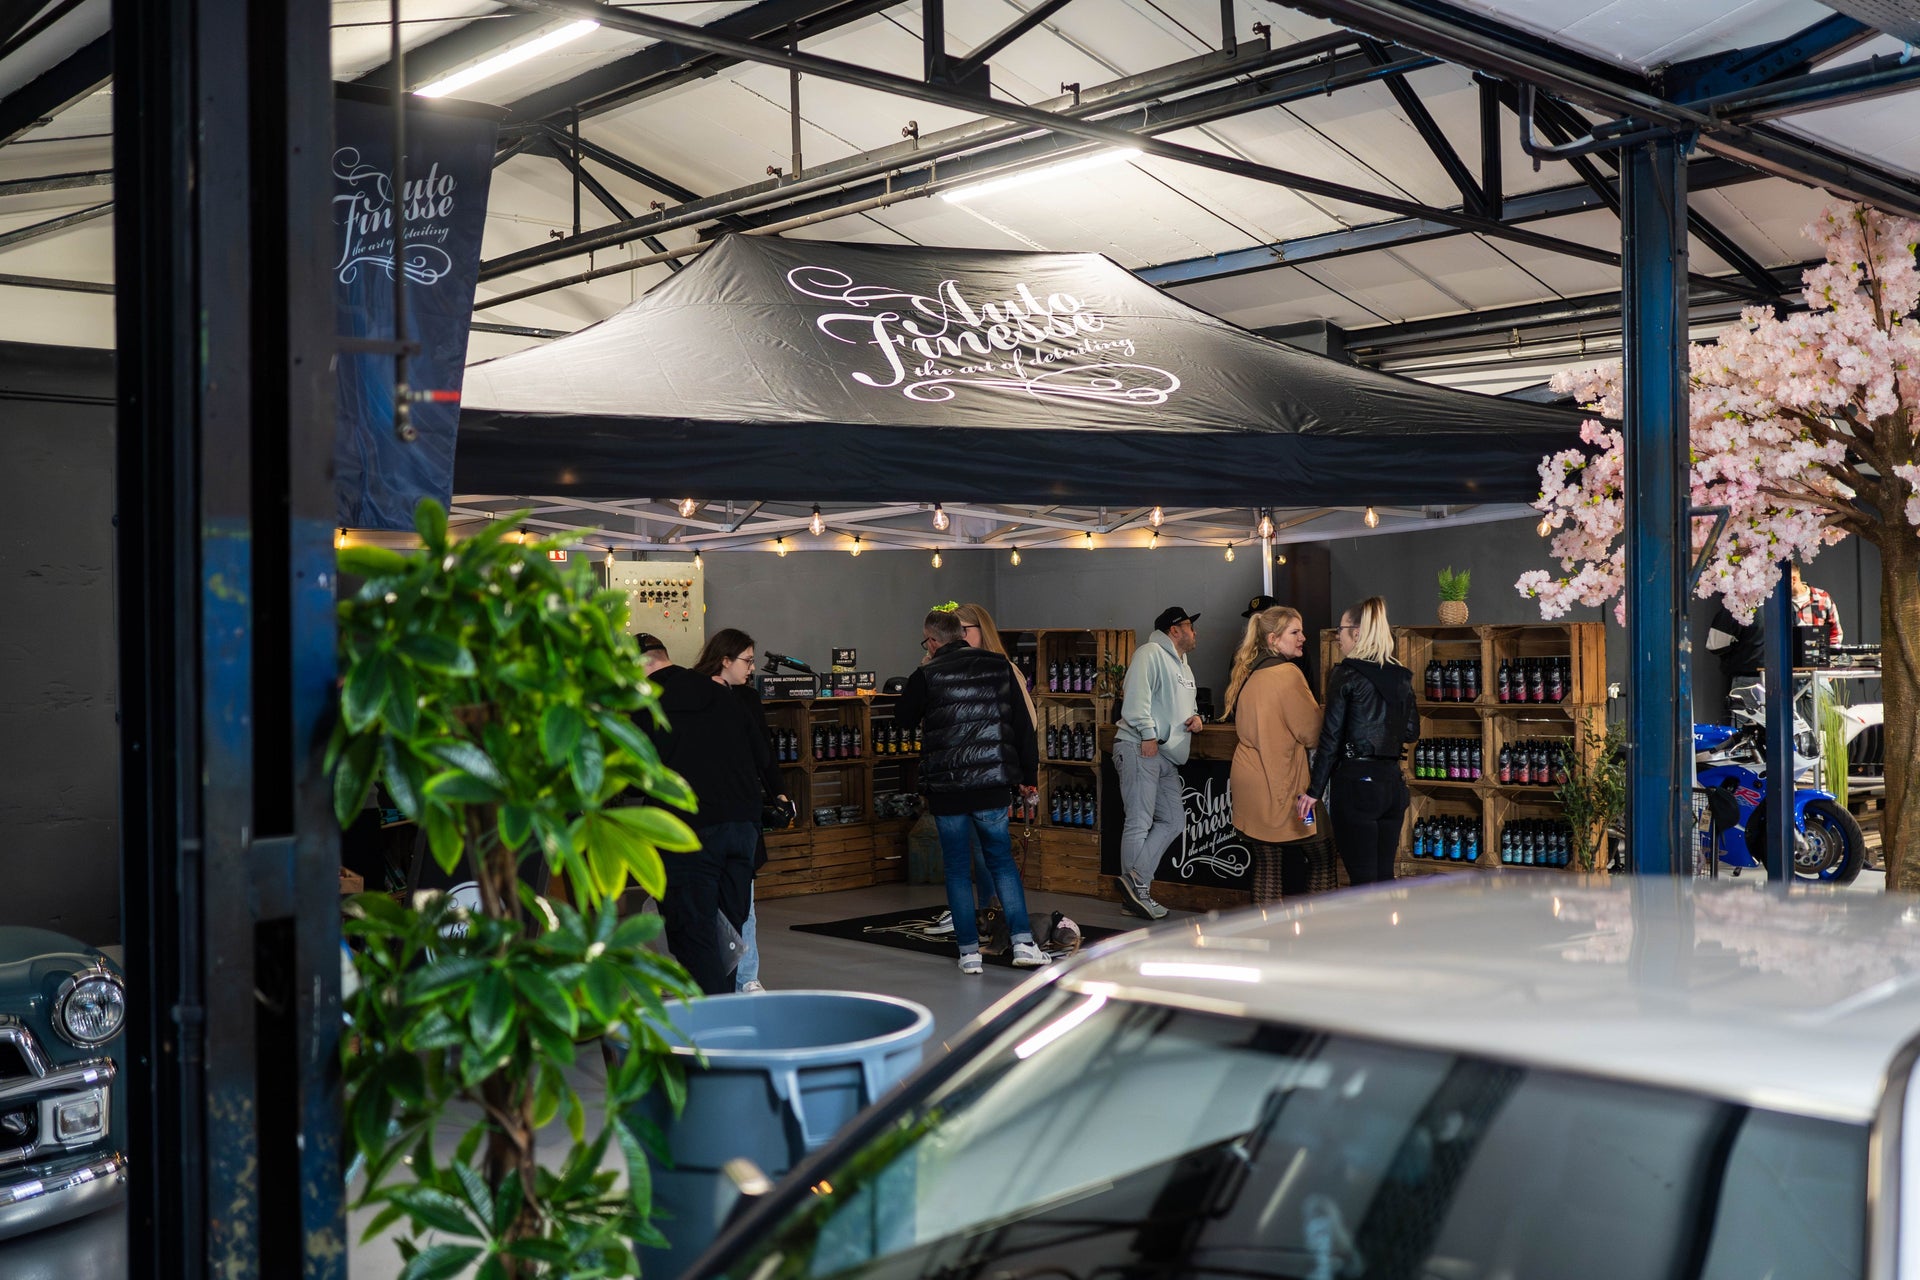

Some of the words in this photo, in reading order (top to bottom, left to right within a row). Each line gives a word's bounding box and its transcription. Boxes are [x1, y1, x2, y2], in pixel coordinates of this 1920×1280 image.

[332, 191, 455, 269] Finsse
[352, 238, 366, 257] the
[368, 237, 384, 251] art
[401, 224, 449, 243] etailing
[817, 311, 1105, 388] Finesse
[914, 359, 954, 378] the
[960, 361, 996, 376] art
[1002, 352, 1027, 379] of
[1029, 336, 1136, 366] detailing
[1172, 808, 1233, 868] Finess
[1188, 842, 1198, 857] the
[1199, 841, 1209, 852] art
[1209, 832, 1218, 854] of
